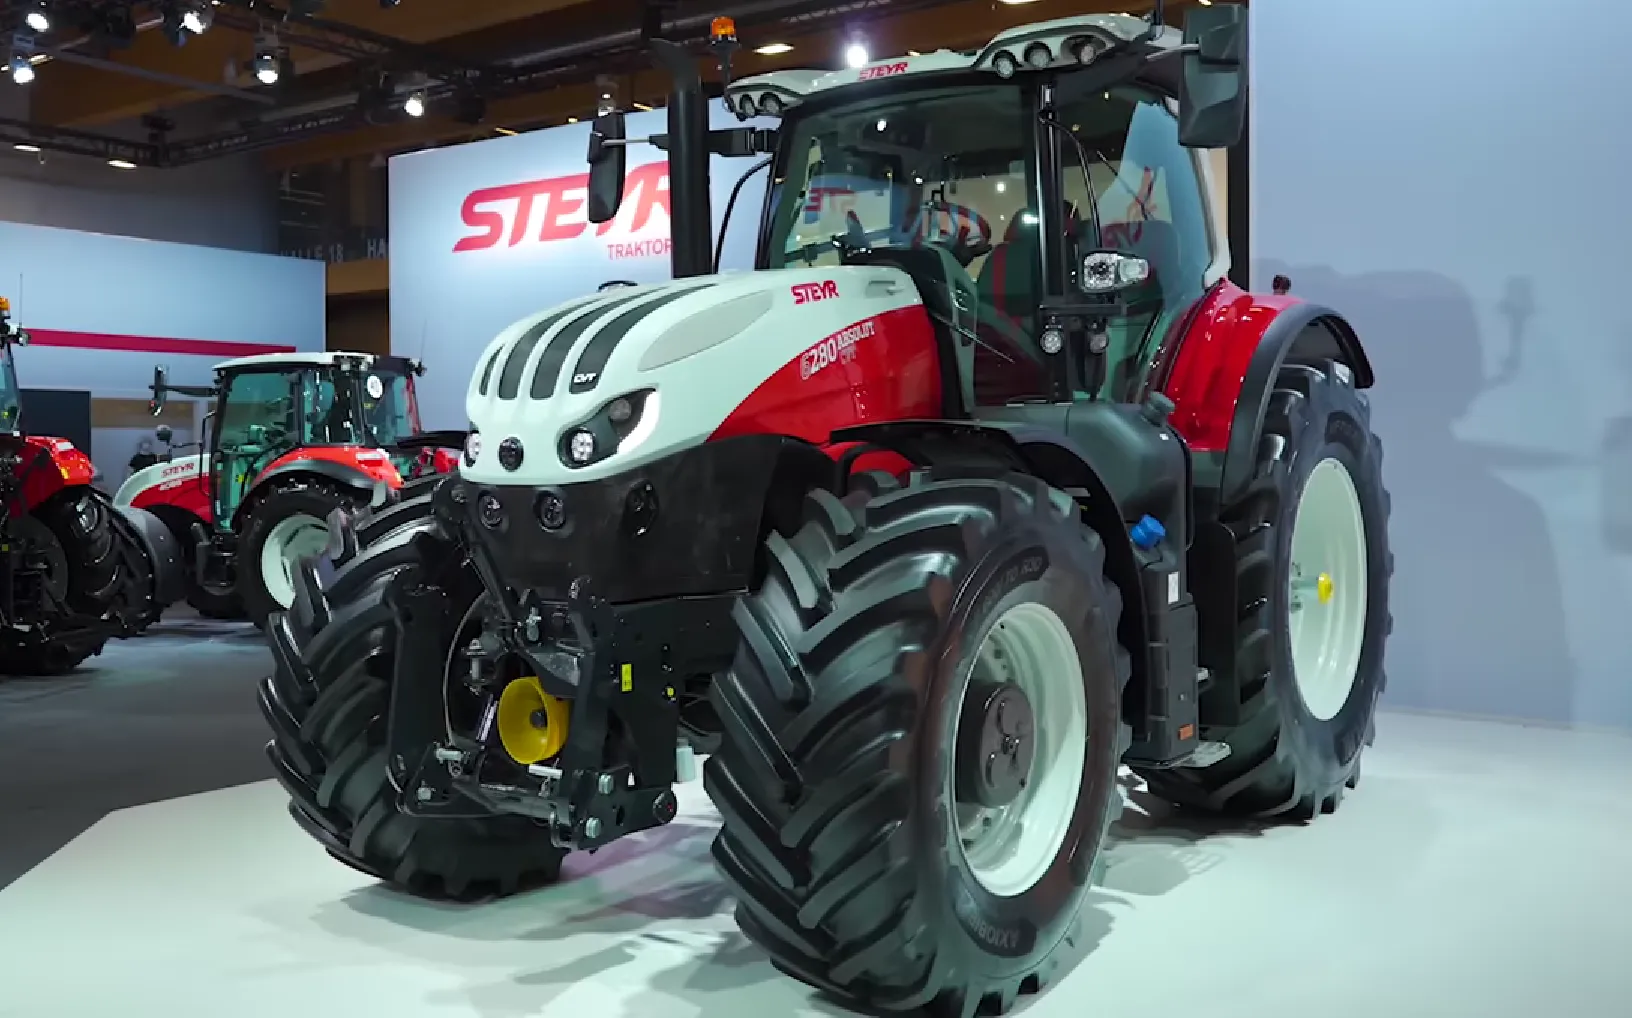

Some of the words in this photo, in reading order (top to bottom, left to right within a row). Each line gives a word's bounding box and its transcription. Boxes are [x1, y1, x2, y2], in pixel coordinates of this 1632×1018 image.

[860, 61, 909, 80] STEYR
[791, 279, 840, 305] STEYR
[800, 337, 838, 380] 6280
[837, 321, 875, 349] ABSOLUT
[162, 463, 194, 477] STEYR
